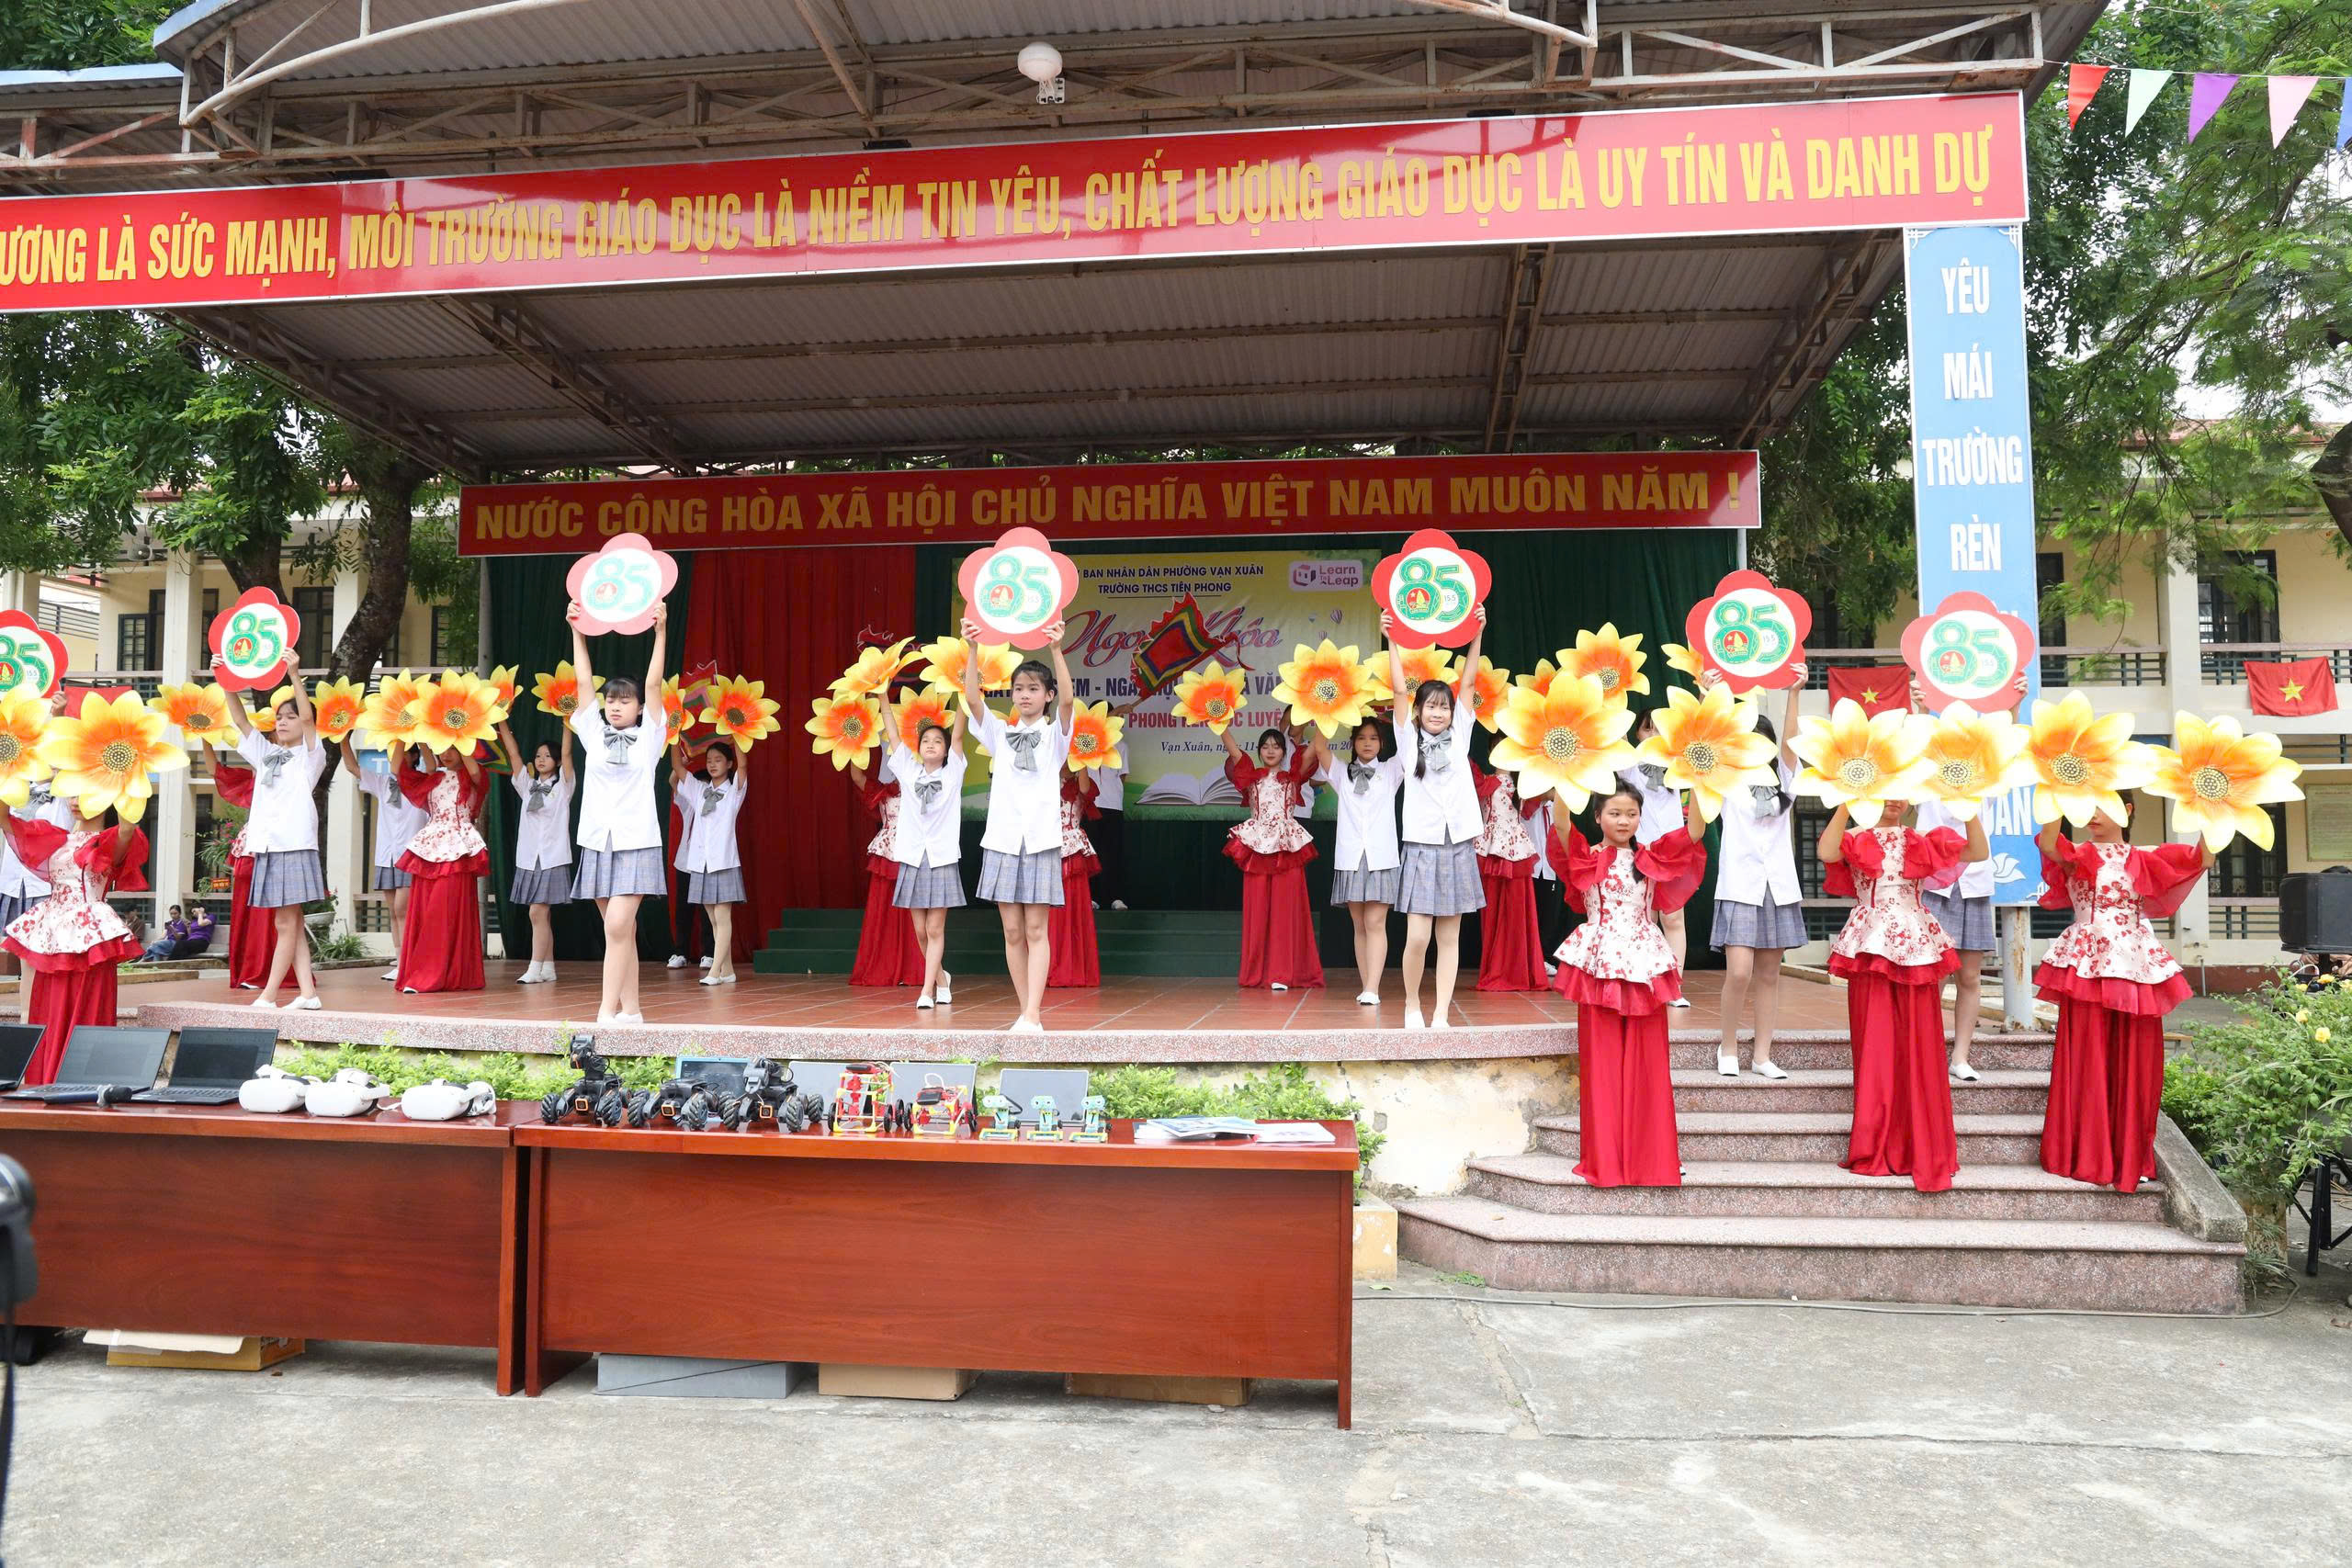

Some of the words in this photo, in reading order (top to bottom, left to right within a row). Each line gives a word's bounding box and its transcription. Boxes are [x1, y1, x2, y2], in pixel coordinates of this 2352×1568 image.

[96, 214, 136, 281] LÀ
[147, 211, 215, 279] SỨC
[225, 217, 336, 288] MẠNH,
[348, 199, 415, 270] MÔI
[426, 194, 563, 265] TRƯỜNG
[575, 187, 656, 258] GIÁO
[670, 193, 741, 264] DỤC
[753, 178, 797, 248] LÀ
[808, 167, 905, 245] NIỀM
[917, 181, 978, 239] TIN
[989, 164, 1072, 240] YÊU,
[1085, 148, 1183, 231] CHẤT
[1196, 159, 1324, 237] LƯỢNG
[1338, 146, 1429, 220] GIÁO
[1442, 152, 1522, 227] DỤC
[1536, 138, 1586, 210] LÀ
[1598, 147, 1647, 209] UY
[1660, 132, 1727, 206] TÍN
[1739, 128, 1794, 202] VÀ
[1806, 134, 1920, 199] DANH
[1933, 123, 1993, 207] DỰ
[1940, 256, 1990, 315] YÊU
[1943, 343, 1994, 400] MÁI
[1922, 425, 2023, 486] TRƯỜNG
[476, 496, 584, 539] NƯỚC
[597, 492, 707, 536] CÔNG
[722, 487, 804, 532] HÒA
[817, 485, 873, 529] XÃ
[887, 483, 956, 535] HỘI
[971, 474, 1057, 525] CHỦ
[1072, 476, 1207, 522] NGHĨA
[1221, 472, 1314, 525] VIỆT
[1329, 478, 1432, 516] NAM
[1450, 467, 1586, 514] MUÔN
[1602, 465, 1709, 511] NĂM
[1083, 569, 1102, 578] BAN
[1106, 566, 1136, 578] NHÂN
[1138, 565, 1159, 577] DÂN
[1163, 564, 1206, 576] PHƯỜNG
[1210, 566, 1232, 578] VẠN
[1235, 563, 1264, 575] XUÂN
[1319, 565, 1355, 574] Learn
[1951, 513, 2002, 571] RÈN
[978, 555, 1052, 623] 85
[1098, 581, 1139, 593] TRƯỜNG
[1143, 582, 1168, 592] THCS
[1194, 582, 1231, 592] PHONG
[1328, 576, 1359, 587] Leap
[1396, 558, 1469, 622] 85
[227, 613, 280, 668] 85
[1713, 600, 1790, 664] 85
[1928, 620, 2009, 687] 85
[1129, 713, 1176, 728] PHONG
[1161, 741, 1181, 754] Vạn
